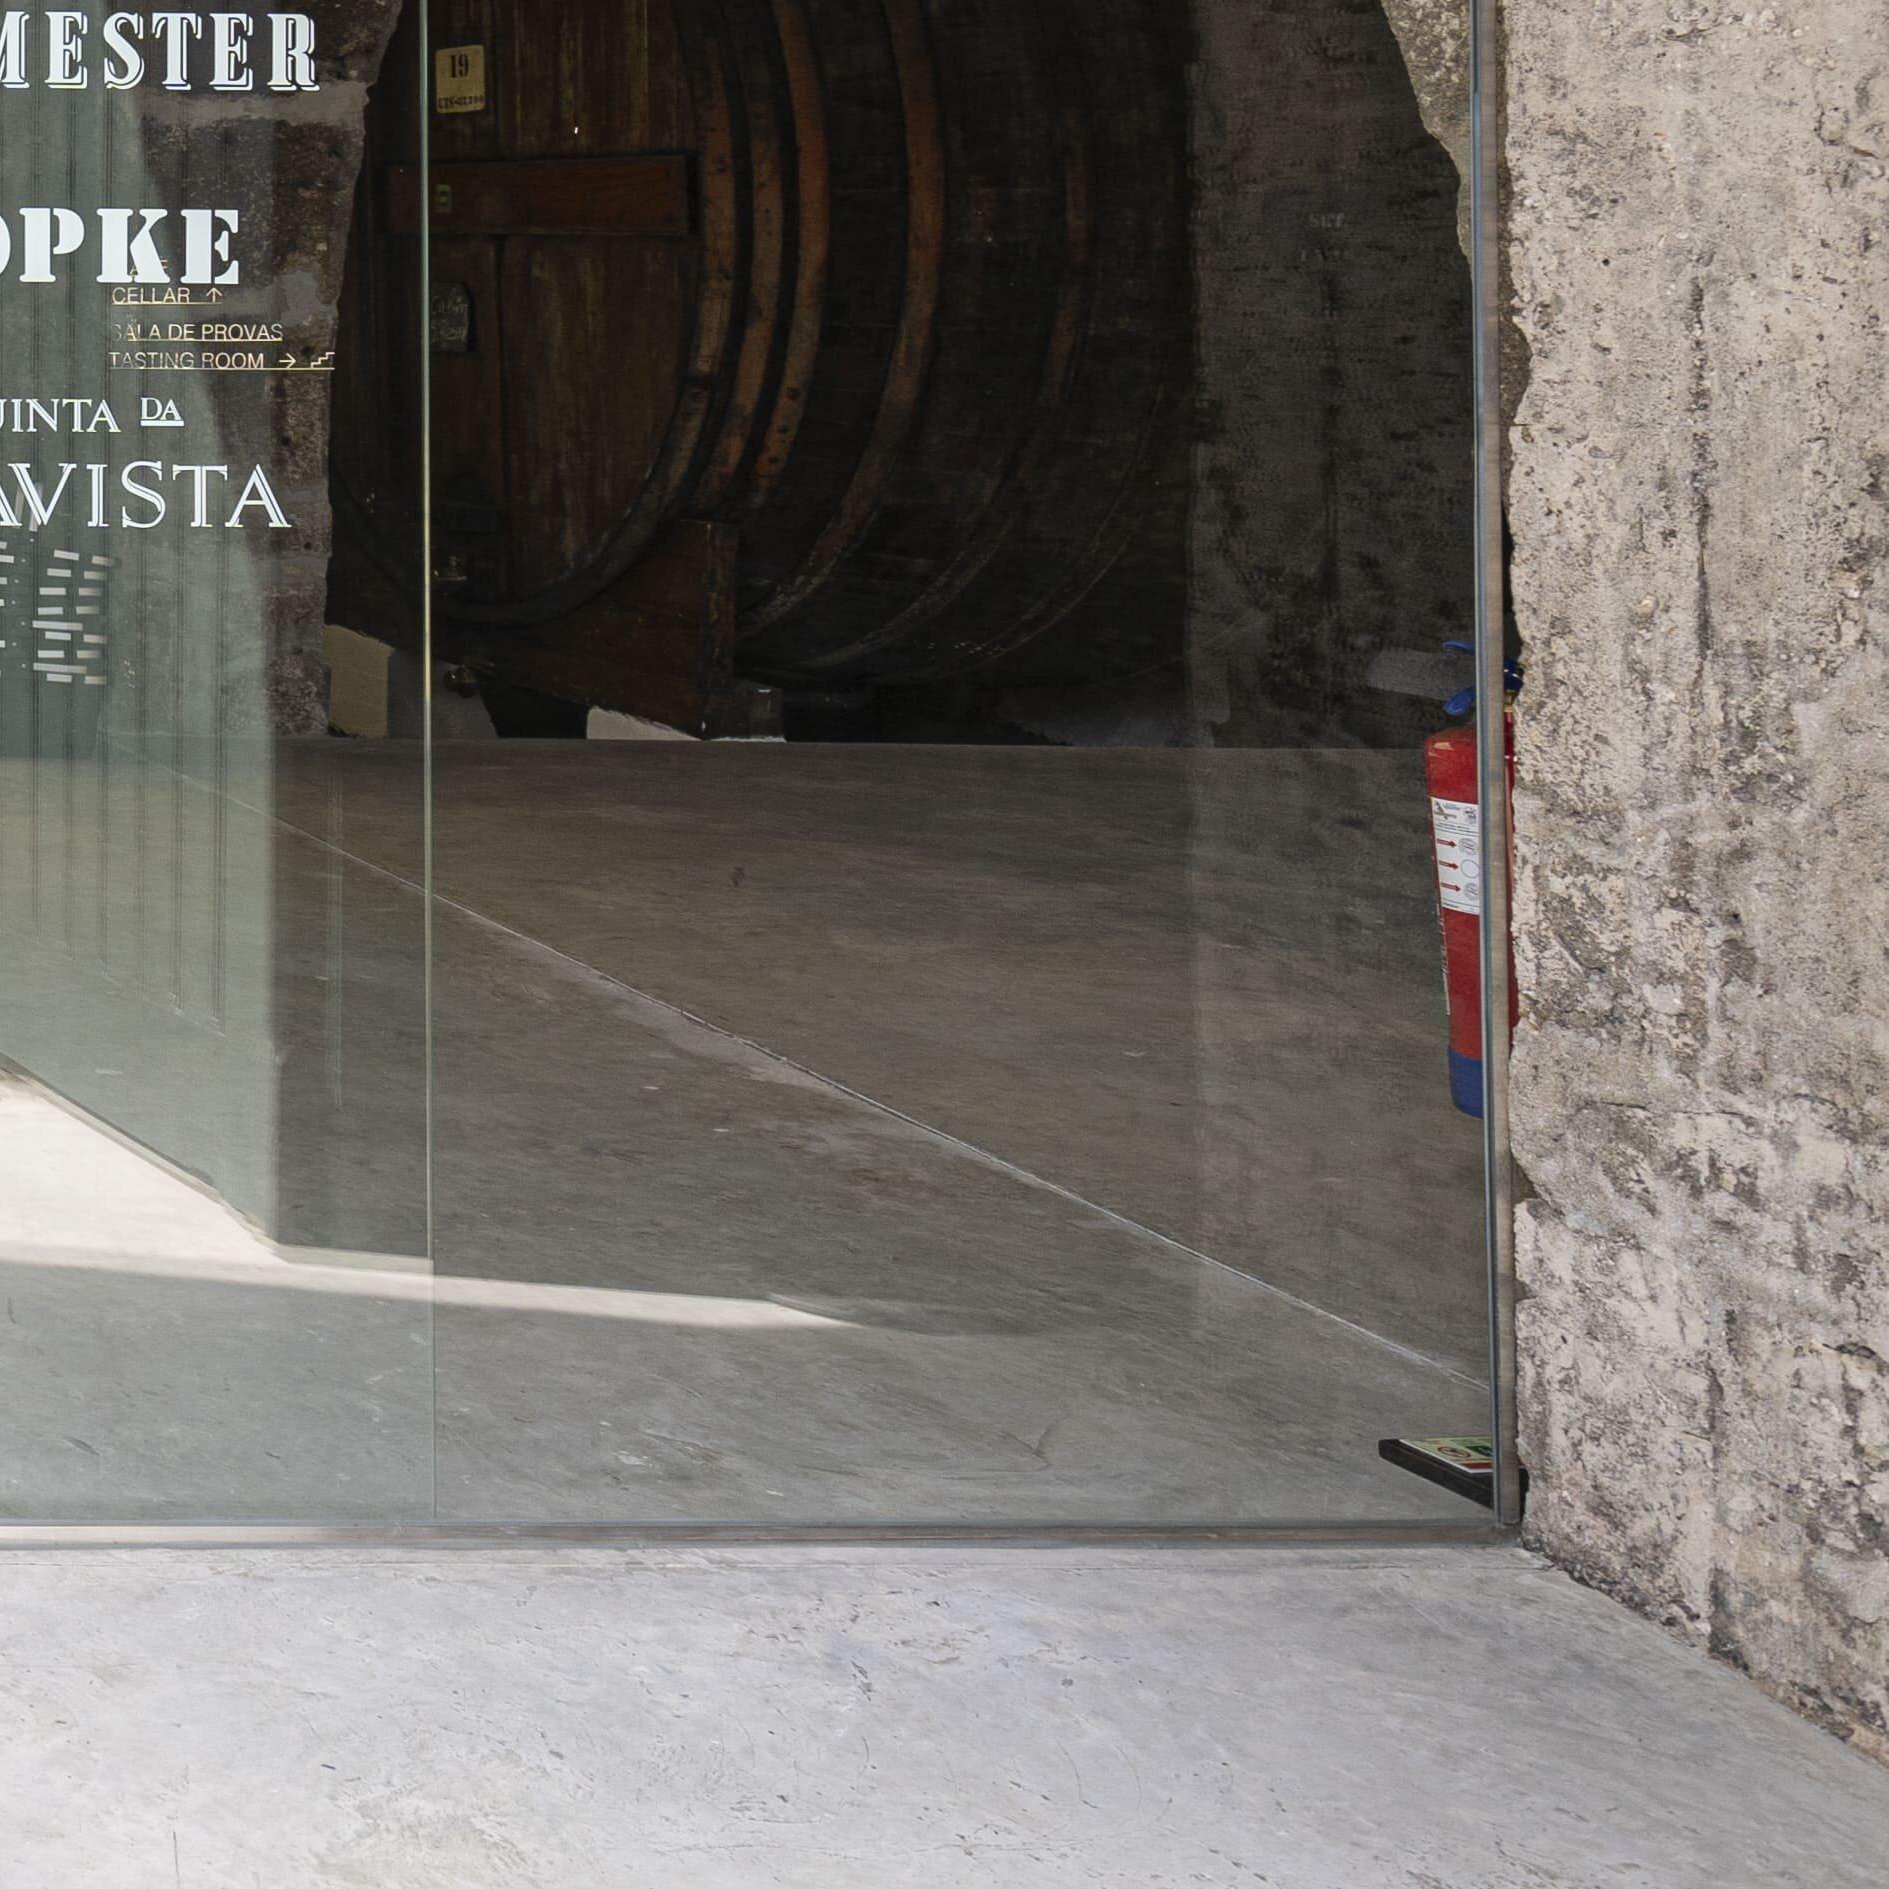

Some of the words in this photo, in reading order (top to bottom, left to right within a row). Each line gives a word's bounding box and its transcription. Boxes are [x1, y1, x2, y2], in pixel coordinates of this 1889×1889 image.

[450, 54, 469, 78] 19
[111, 287, 190, 304] CELLAR
[110, 323, 161, 340] SALA
[168, 323, 195, 340] DE
[201, 323, 283, 340] PROVAS
[109, 351, 195, 369] TASTING
[201, 351, 264, 369] ROOM
